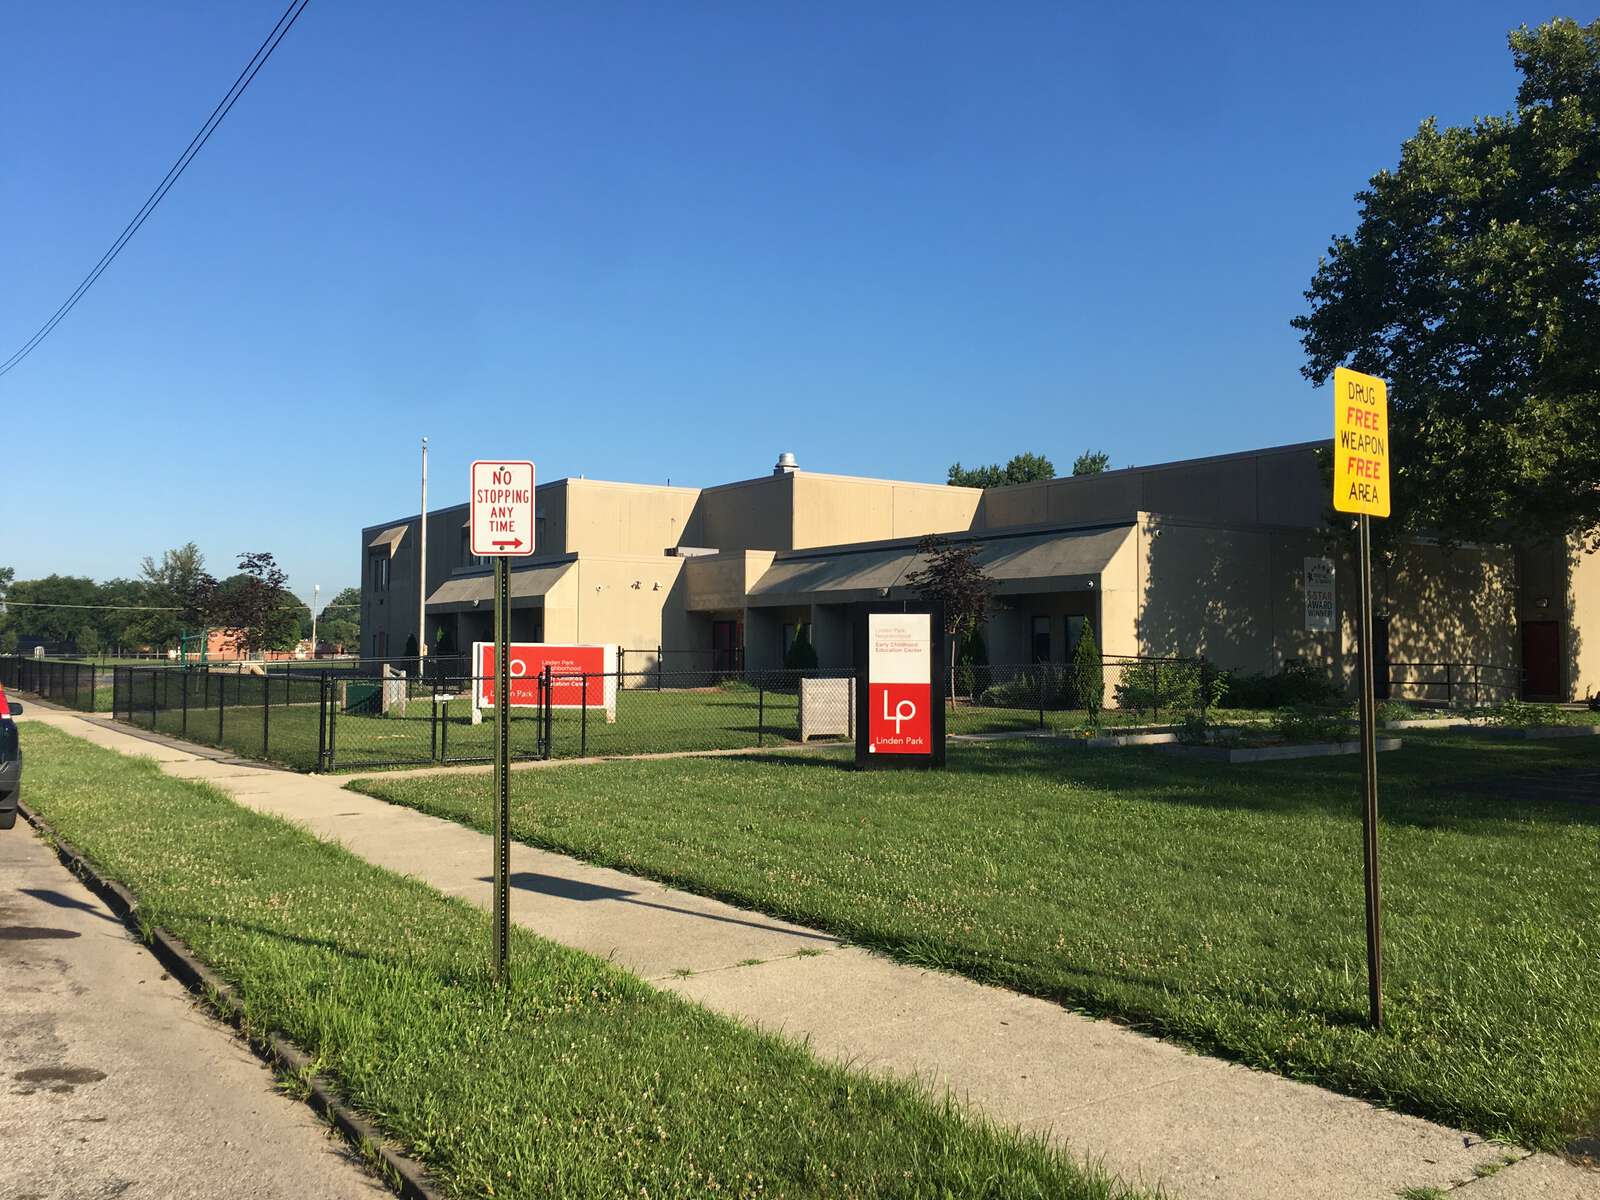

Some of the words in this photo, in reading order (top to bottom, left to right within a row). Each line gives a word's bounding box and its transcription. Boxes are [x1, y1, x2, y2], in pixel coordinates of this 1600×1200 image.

[1348, 381, 1375, 406] DRUG
[1347, 406, 1379, 431] FREE
[1341, 430, 1384, 456] WEAPON
[1347, 456, 1381, 480] FREE
[492, 471, 512, 485] NO
[477, 489, 529, 504] STOPPING
[1349, 481, 1379, 504] AREA
[490, 506, 514, 518] ANY
[489, 520, 515, 532] TIME
[1307, 600, 1333, 609] AWARD
[1308, 609, 1333, 617] WINNER
[516, 690, 533, 698] Park
[876, 736, 904, 745] Linden
[906, 736, 924, 745] Park
